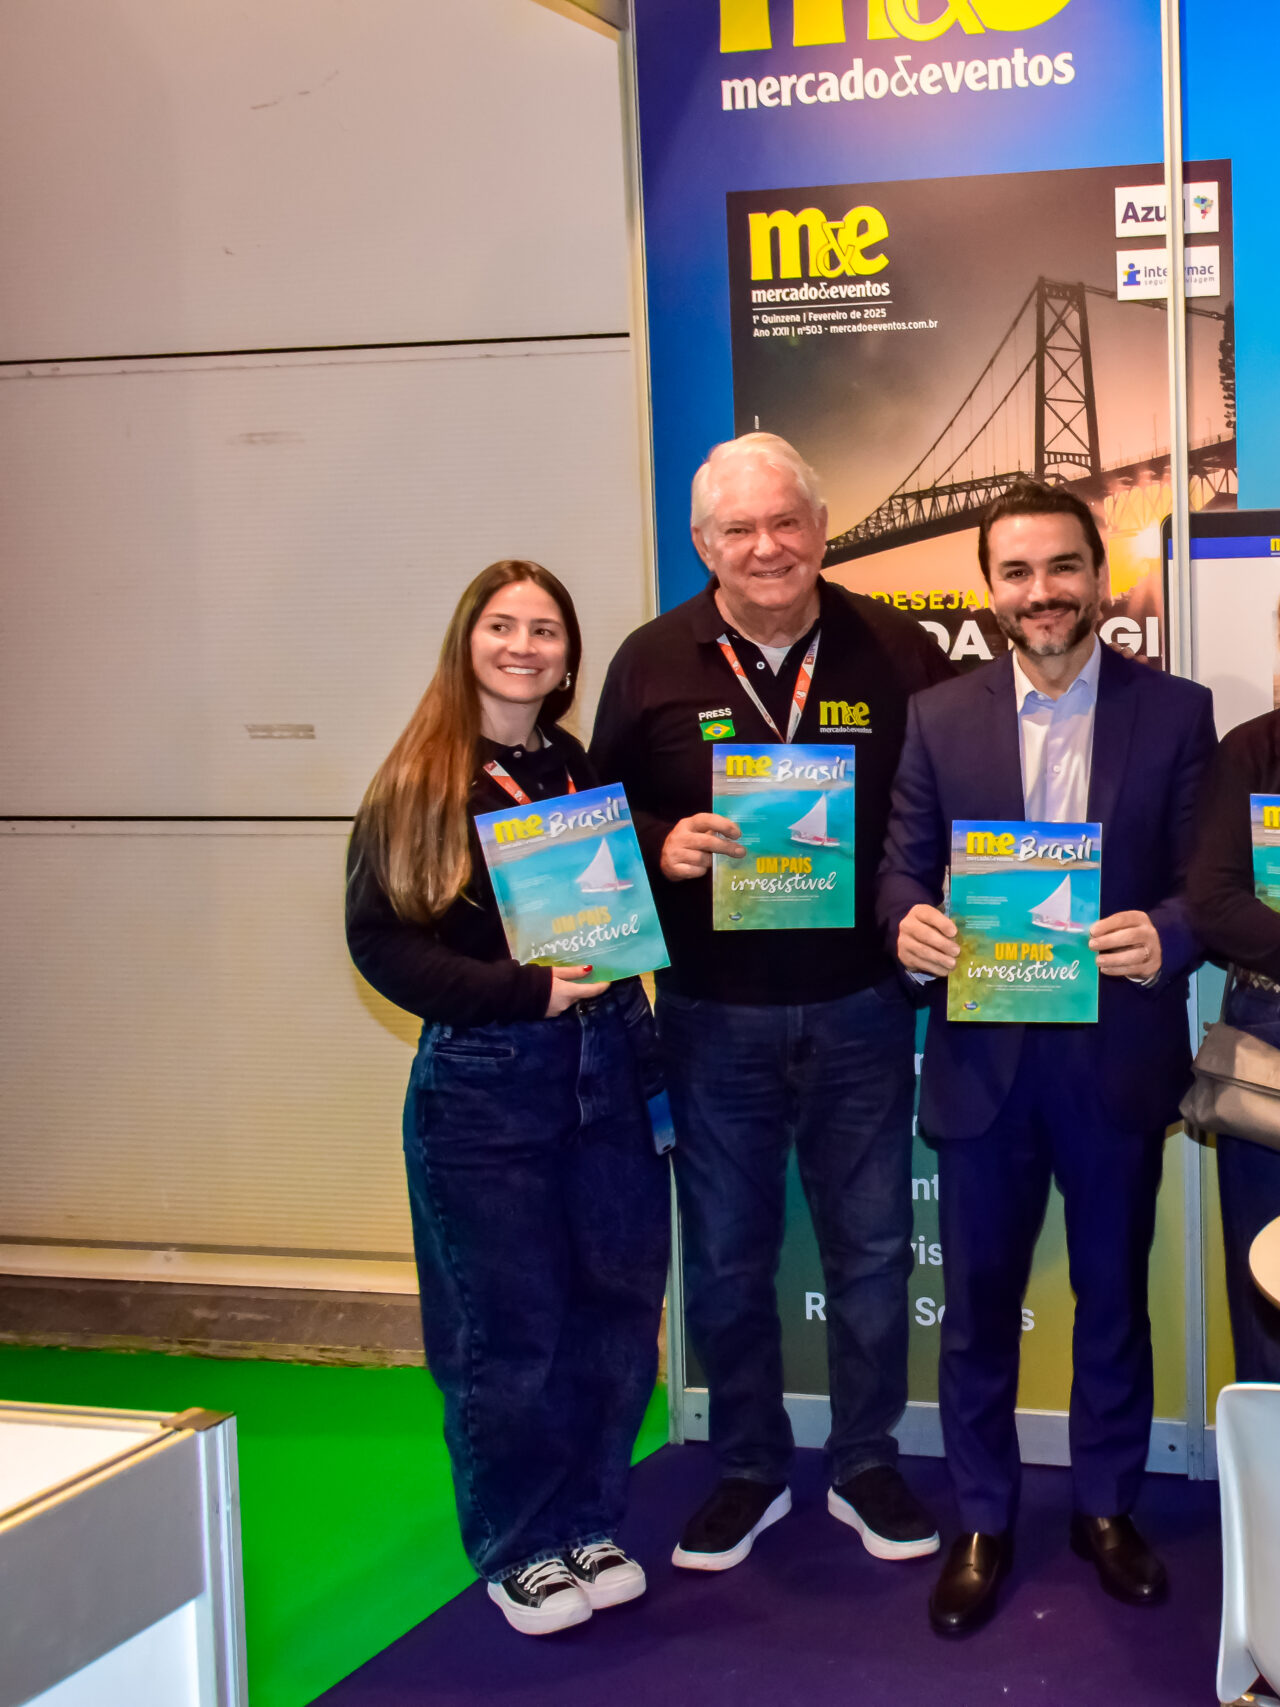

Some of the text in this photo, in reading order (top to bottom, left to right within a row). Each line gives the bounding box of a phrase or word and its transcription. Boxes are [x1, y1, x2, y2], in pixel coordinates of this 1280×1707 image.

[722, 48, 1075, 110] mercado&eventos
[1121, 199, 1186, 224] Azu
[748, 205, 890, 280] m&e
[752, 281, 890, 303] mercado&eventos
[762, 313, 800, 324] Quinzena
[808, 311, 848, 322] Fevereiro
[850, 309, 861, 319] de
[864, 309, 886, 319] 2025
[753, 327, 770, 337] Ano
[772, 327, 790, 337] XXII
[830, 320, 938, 334] mercadoeeventos.com.br
[872, 590, 989, 611] DESEJA
[698, 707, 732, 722] PRESS
[819, 701, 870, 726] m&e
[777, 756, 846, 785] Brasil
[549, 797, 621, 838] Brasil
[1017, 834, 1092, 865] Brasil
[756, 858, 778, 873] UM
[994, 943, 1017, 961] UM
